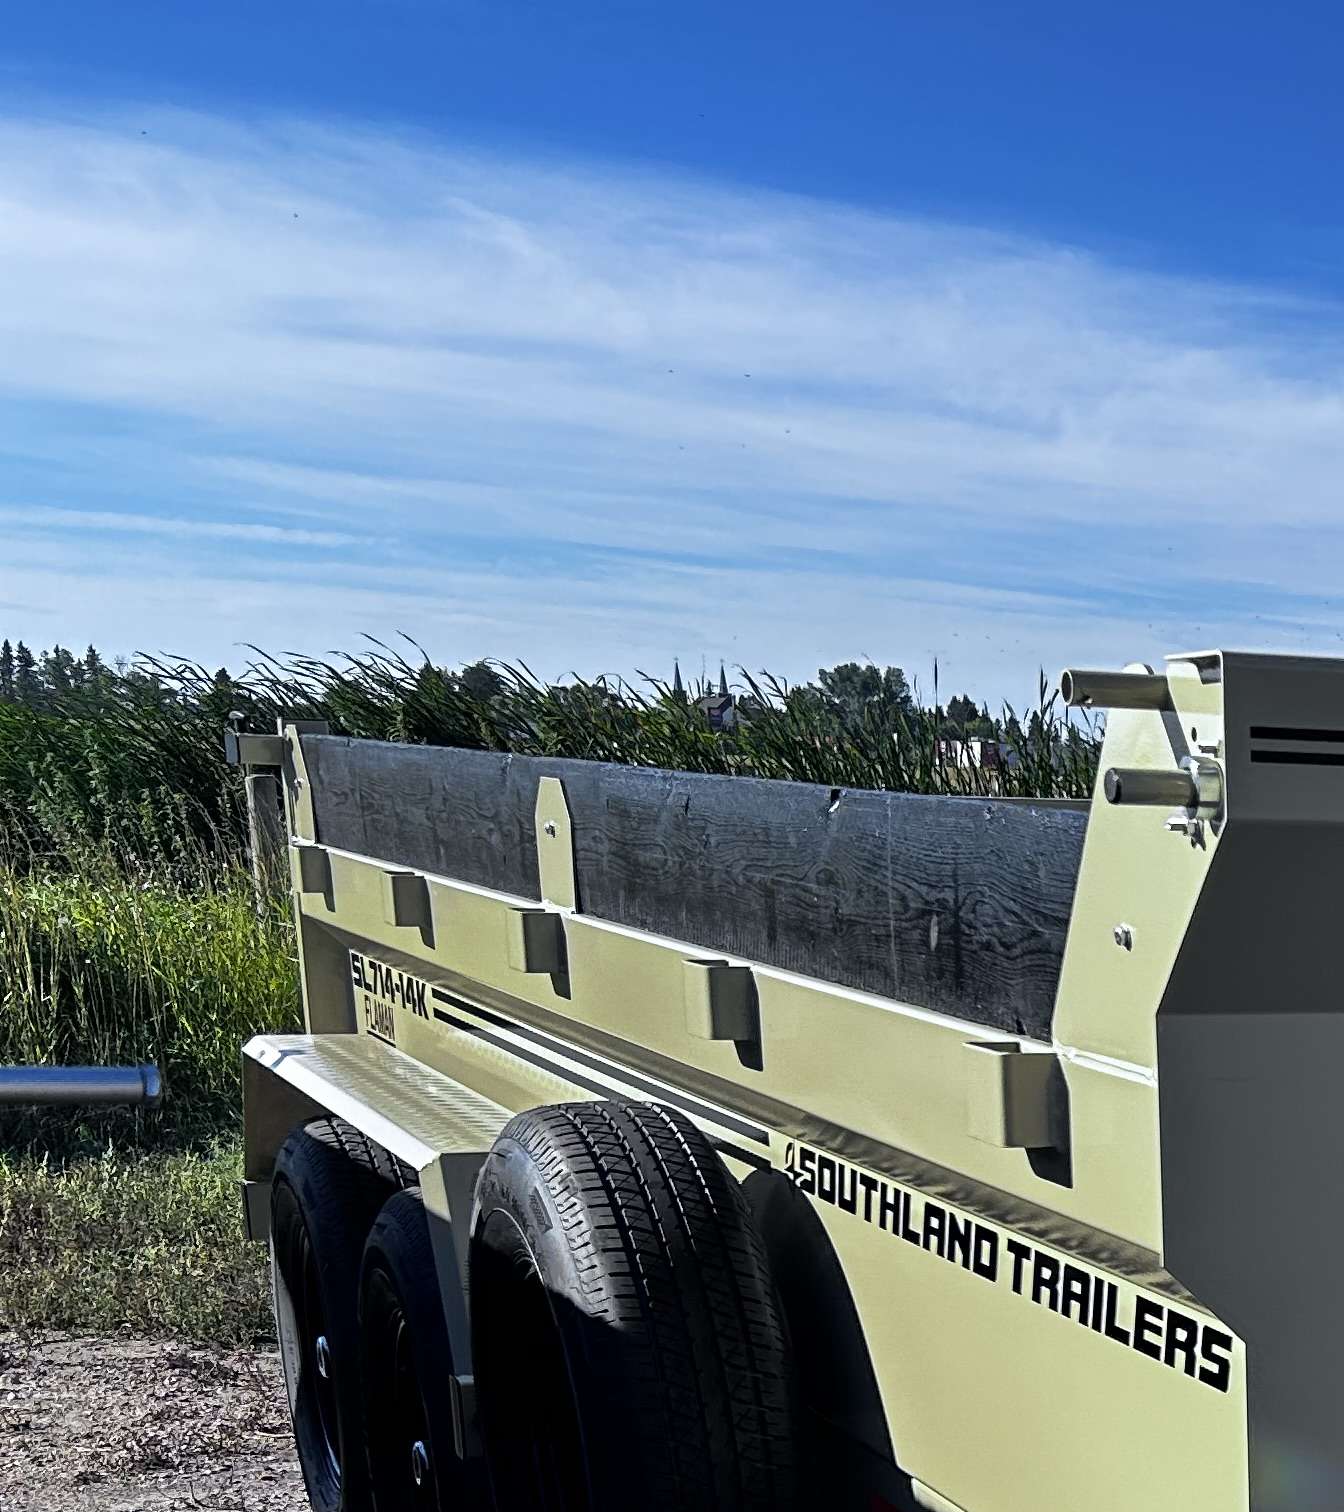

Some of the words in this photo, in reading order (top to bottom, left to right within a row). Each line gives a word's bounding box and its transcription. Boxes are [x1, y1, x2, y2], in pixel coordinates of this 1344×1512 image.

[351, 951, 430, 1020] SL714-14K
[364, 994, 396, 1042] FLAMAN
[799, 1146, 999, 1283] SOUTHLAND
[1007, 1238, 1234, 1395] TRAILERS
